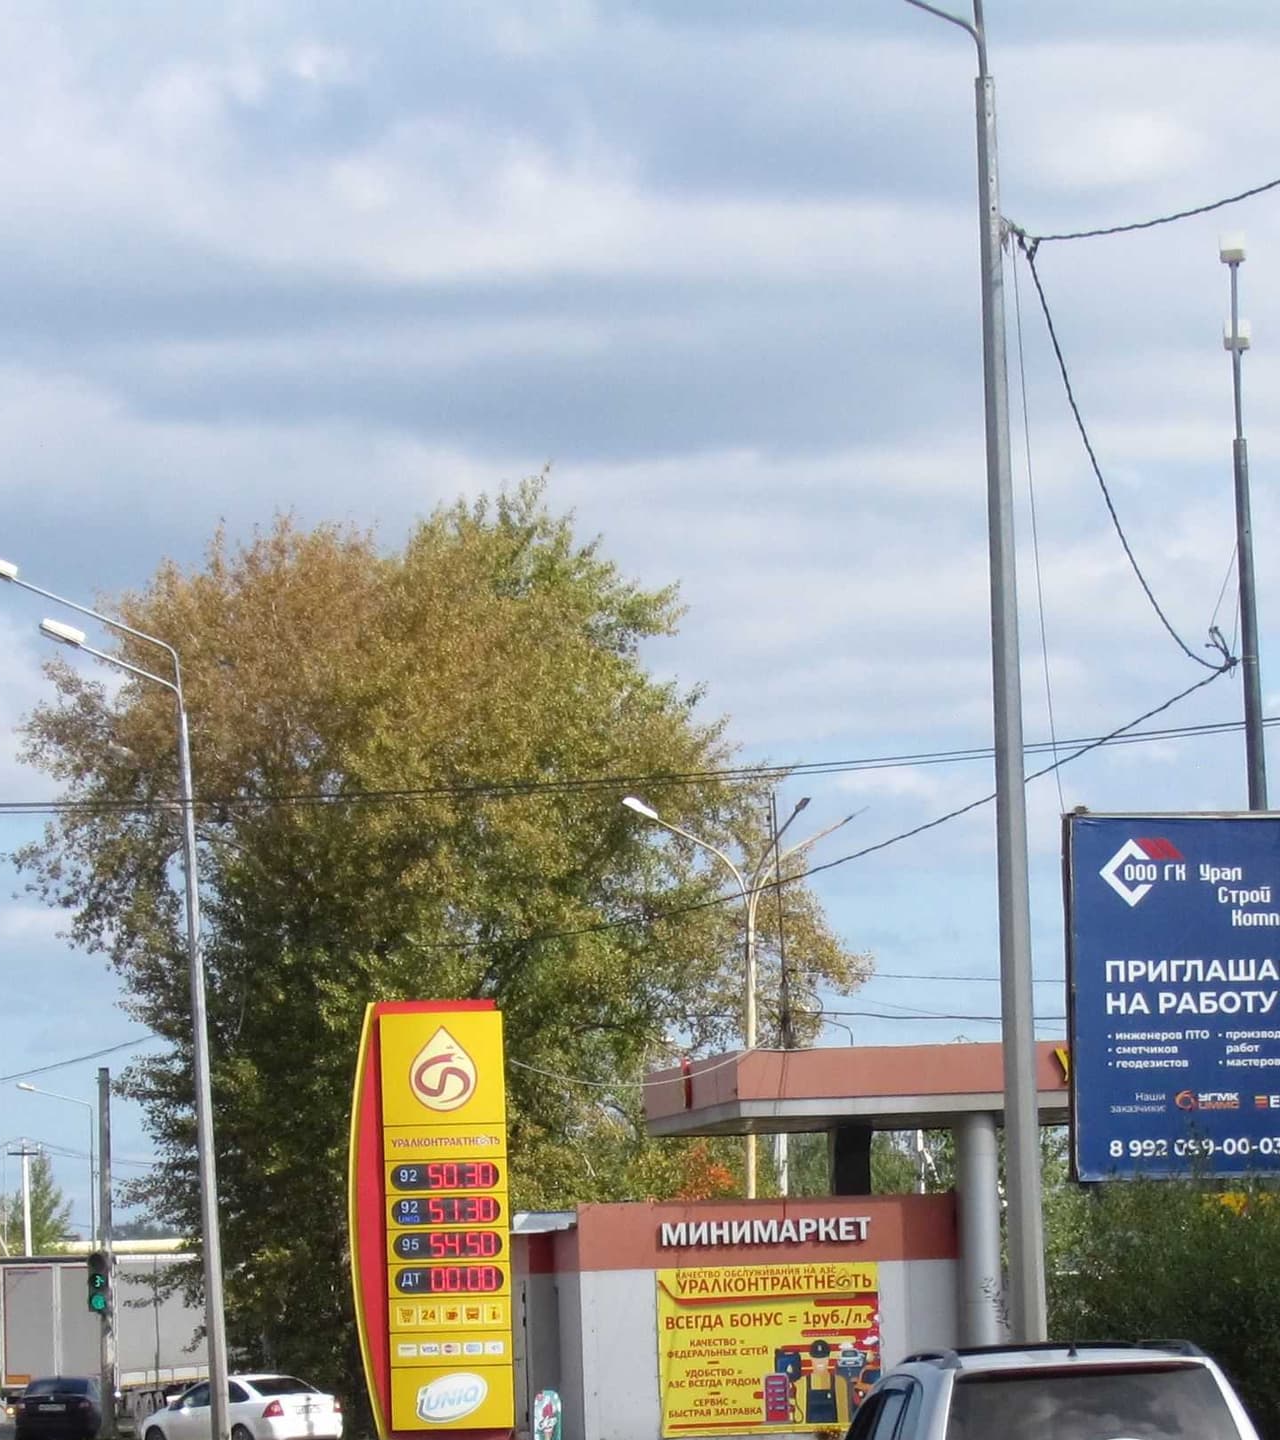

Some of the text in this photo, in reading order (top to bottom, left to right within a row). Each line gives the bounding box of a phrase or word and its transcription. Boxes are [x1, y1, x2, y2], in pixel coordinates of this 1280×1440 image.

[1124, 864, 1242, 884] ООО ГК Урал
[1218, 886, 1271, 906] Строй
[1106, 990, 1278, 1015] НА РАБОТУ
[1115, 1029, 1210, 1043] инженеров ПТО
[1115, 1044, 1178, 1055] сметчиков
[1225, 1043, 1260, 1056] работ
[1115, 1058, 1189, 1069] геодезистов
[1226, 1057, 1280, 1069] мастеров
[1135, 1091, 1166, 1101] Наши
[1109, 1139, 1123, 1157] 8
[1128, 1138, 1168, 1156] 992
[399, 1162, 493, 1189] 92 50.30
[401, 1197, 495, 1223] 92 51.30
[660, 1216, 872, 1247] МИНИМАРКЕТ
[401, 1231, 496, 1257] 95 54.50
[401, 1272, 421, 1287] ДТ
[676, 1271, 721, 1280] КАЧЕСТВО
[724, 1268, 801, 1278] ОБСЛУЖИВАНИЯ
[803, 1266, 817, 1275] НА
[421, 1310, 436, 1320] 24
[666, 1313, 725, 1331] ВСЕГДА
[730, 1311, 783, 1327] БОНУС
[690, 1338, 737, 1348] КАЧЕСТВО
[667, 1345, 768, 1359] ФЕДЕРАЛЬНЫХ СЕТЕЙ
[685, 1367, 735, 1378] УДОБСТВО
[668, 1377, 761, 1389] АЗС ВСЕГДА РЯДОМ
[693, 1397, 729, 1407] СЕРВИС
[668, 1406, 762, 1419] БЫСТРАЯ ЗАПРАВКА
